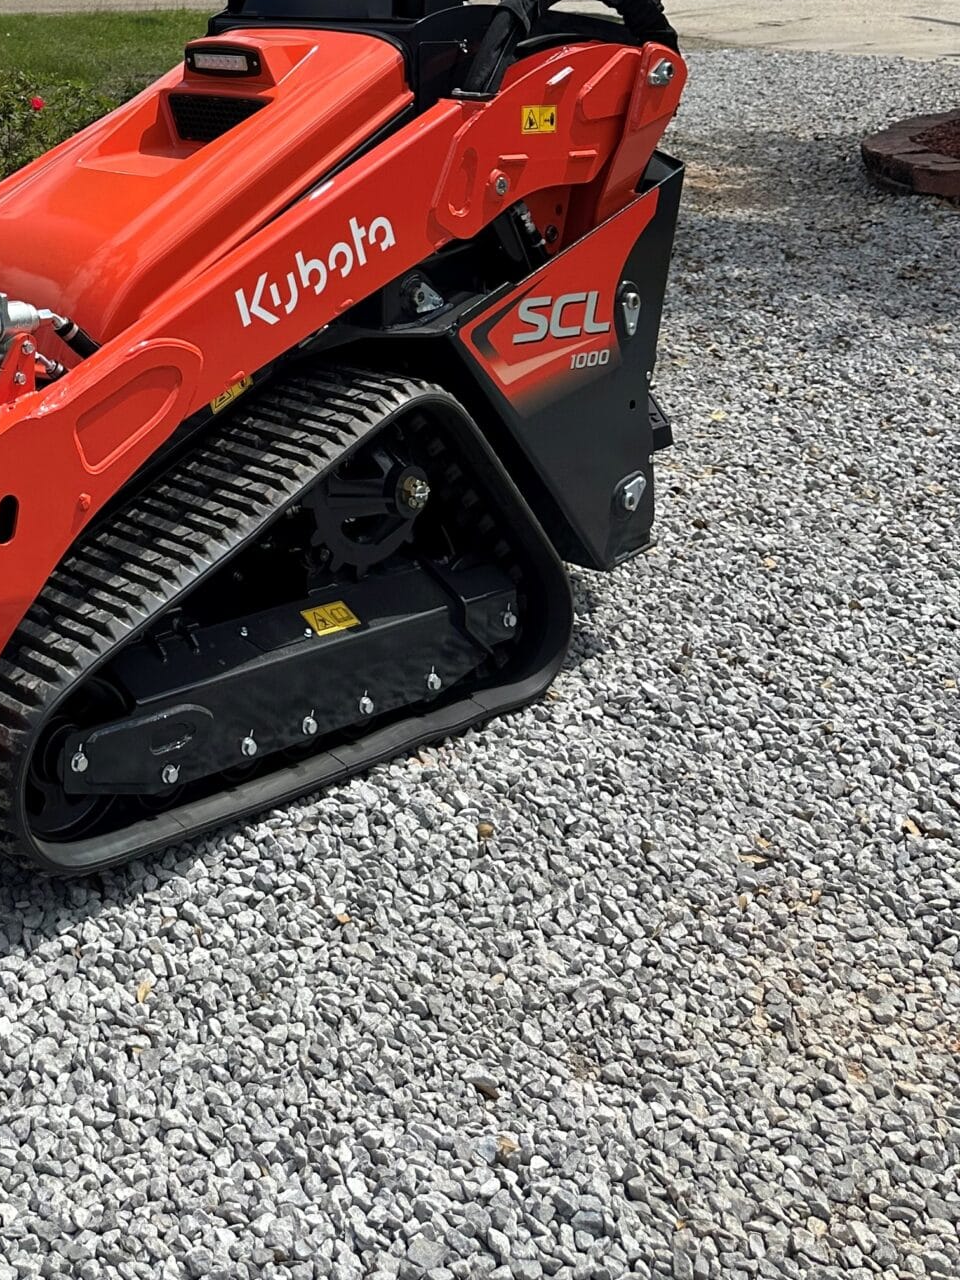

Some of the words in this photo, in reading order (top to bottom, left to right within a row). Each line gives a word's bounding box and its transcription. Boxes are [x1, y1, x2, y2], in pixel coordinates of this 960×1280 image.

[234, 216, 396, 328] Kubota
[512, 290, 611, 345] SCL
[570, 349, 610, 370] 1000
